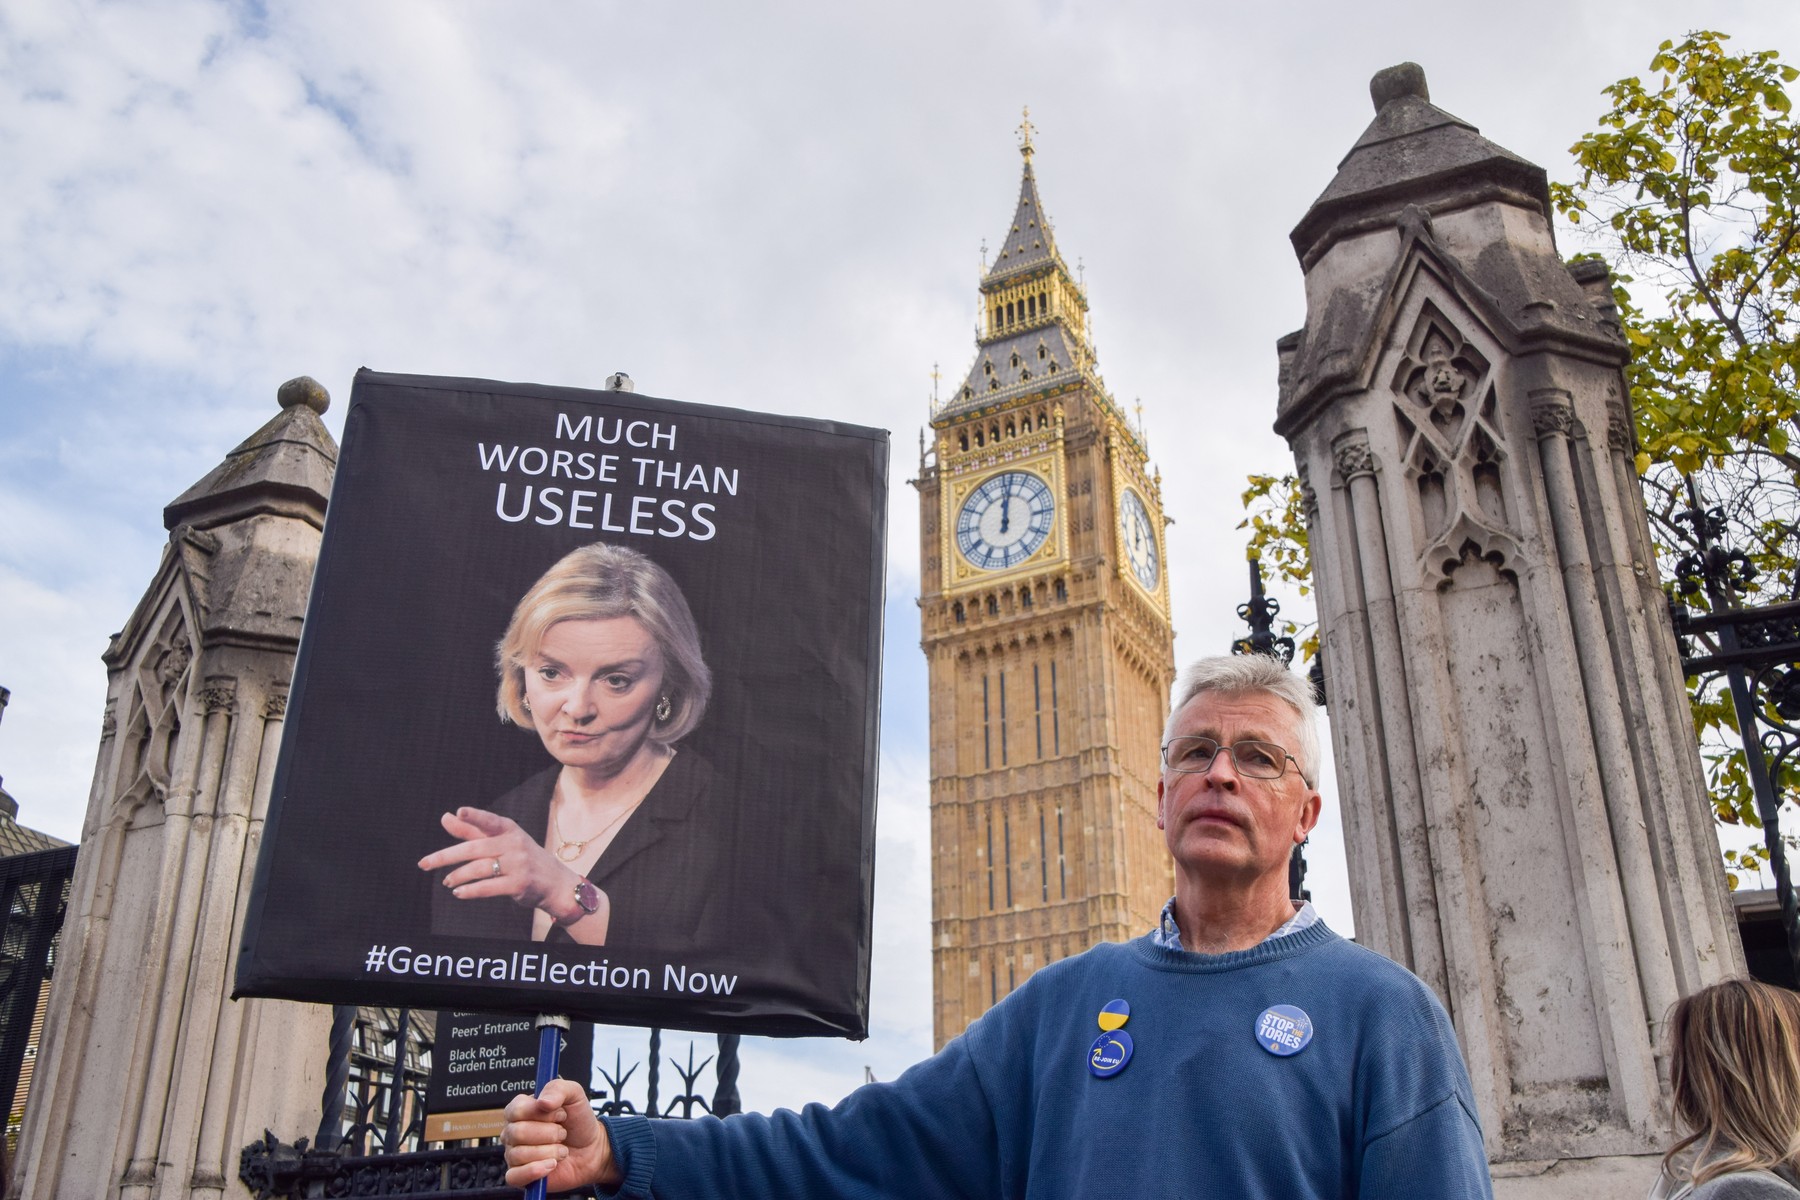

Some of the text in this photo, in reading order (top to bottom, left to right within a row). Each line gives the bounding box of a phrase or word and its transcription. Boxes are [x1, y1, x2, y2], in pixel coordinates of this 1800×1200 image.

[555, 413, 677, 451] MUCH
[478, 443, 739, 496] WORSE THAN
[496, 483, 717, 541] USELESS
[365, 945, 738, 995] #GeneralElection Now
[484, 1021, 530, 1035] Entrance
[1259, 1023, 1301, 1049] TORIES
[1263, 1013, 1294, 1031] STOP
[1291, 1028, 1304, 1038] THE
[448, 1056, 536, 1073] Garden Entrance
[449, 1045, 507, 1061] Black Rod's
[446, 1080, 536, 1097] Education Centre
